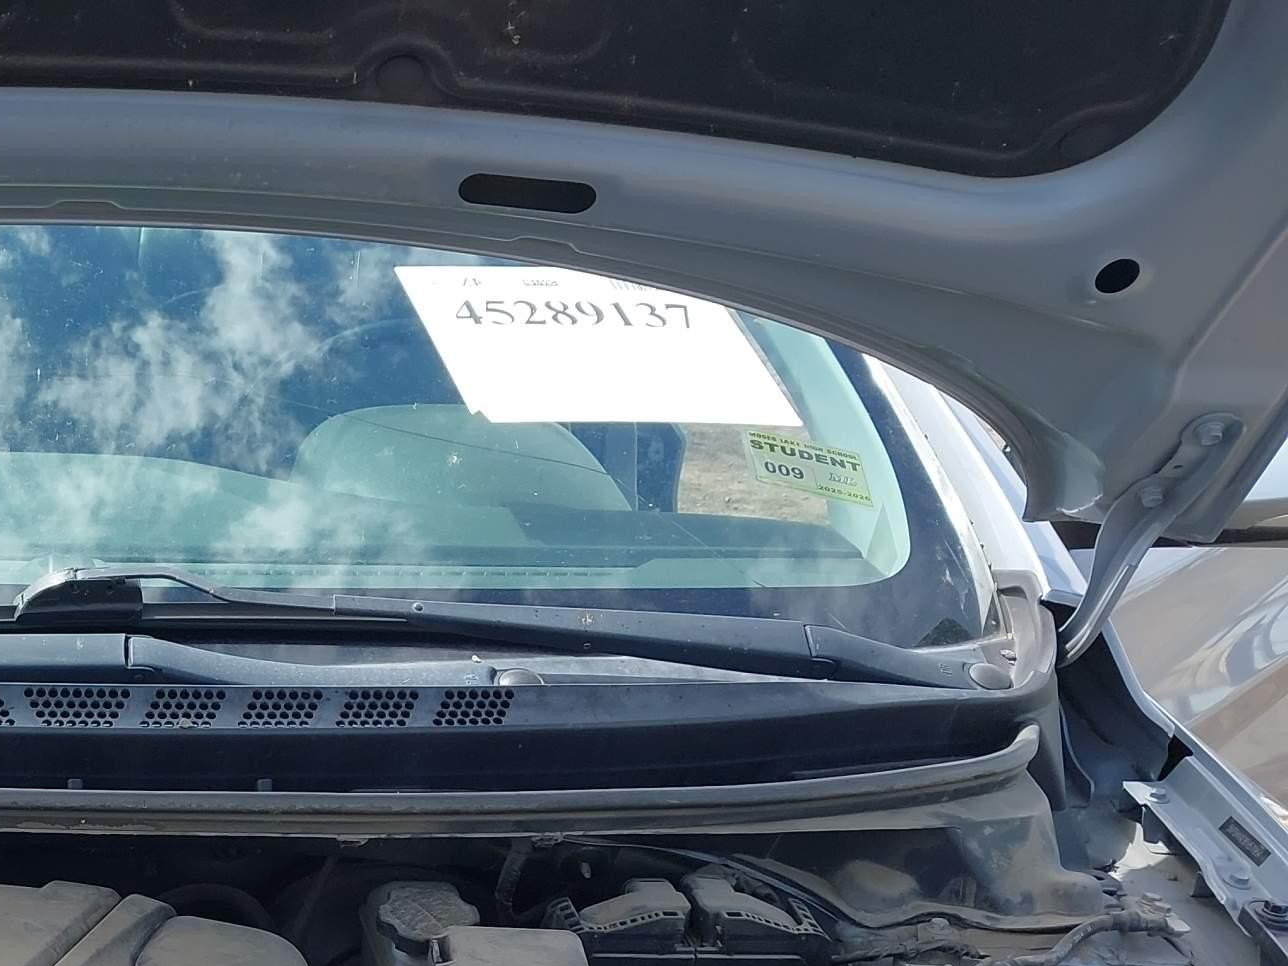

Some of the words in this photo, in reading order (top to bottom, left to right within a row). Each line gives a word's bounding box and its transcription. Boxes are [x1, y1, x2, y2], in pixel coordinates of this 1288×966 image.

[456, 299, 690, 329] 45289137
[750, 439, 861, 472] STUDENT
[764, 461, 805, 480] 009
